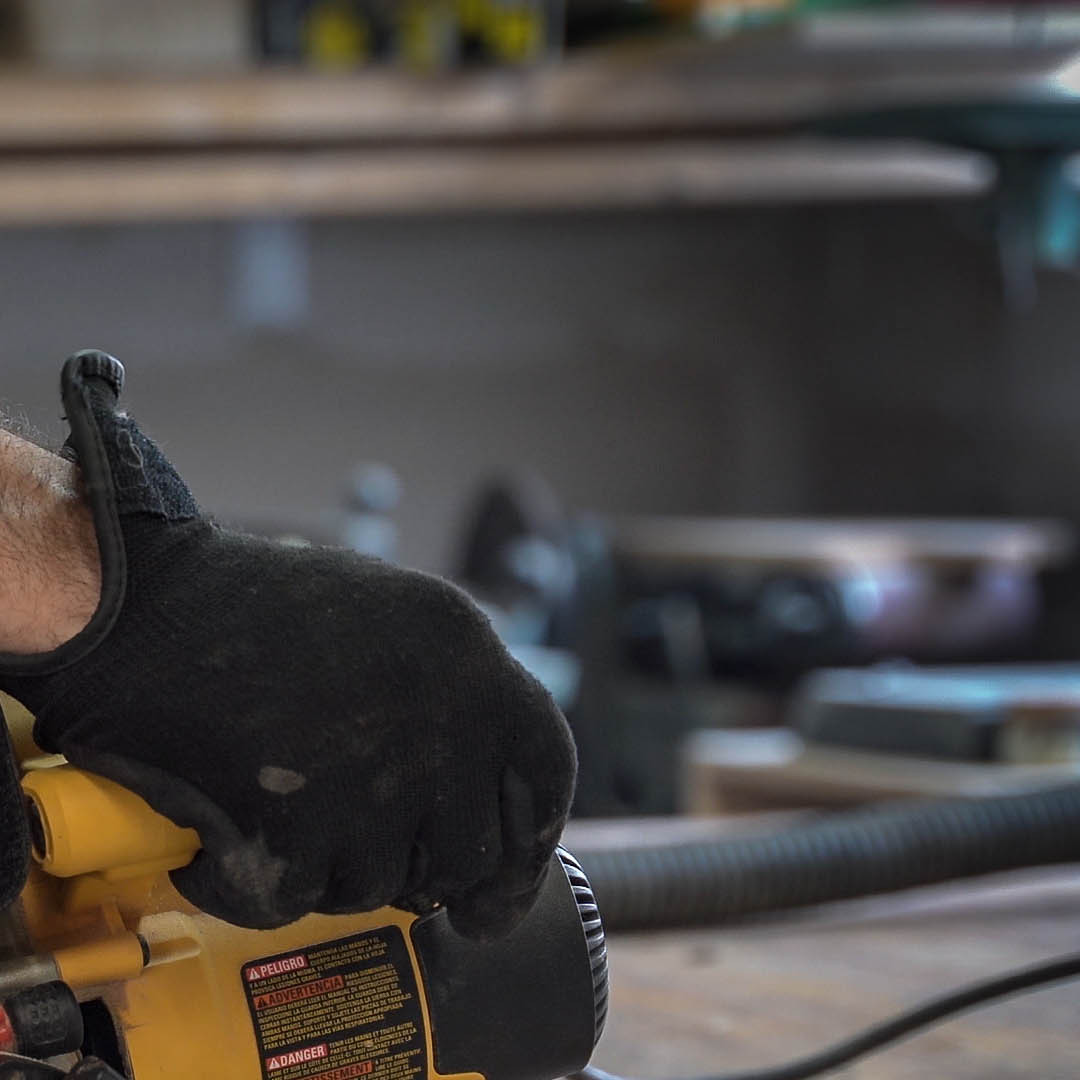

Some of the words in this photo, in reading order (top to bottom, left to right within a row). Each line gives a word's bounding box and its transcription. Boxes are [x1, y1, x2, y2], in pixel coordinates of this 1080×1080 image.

[260, 956, 304, 976] PELIGRO
[269, 977, 340, 1003] ADVERTENCIA
[280, 1046, 324, 1065] DANGER
